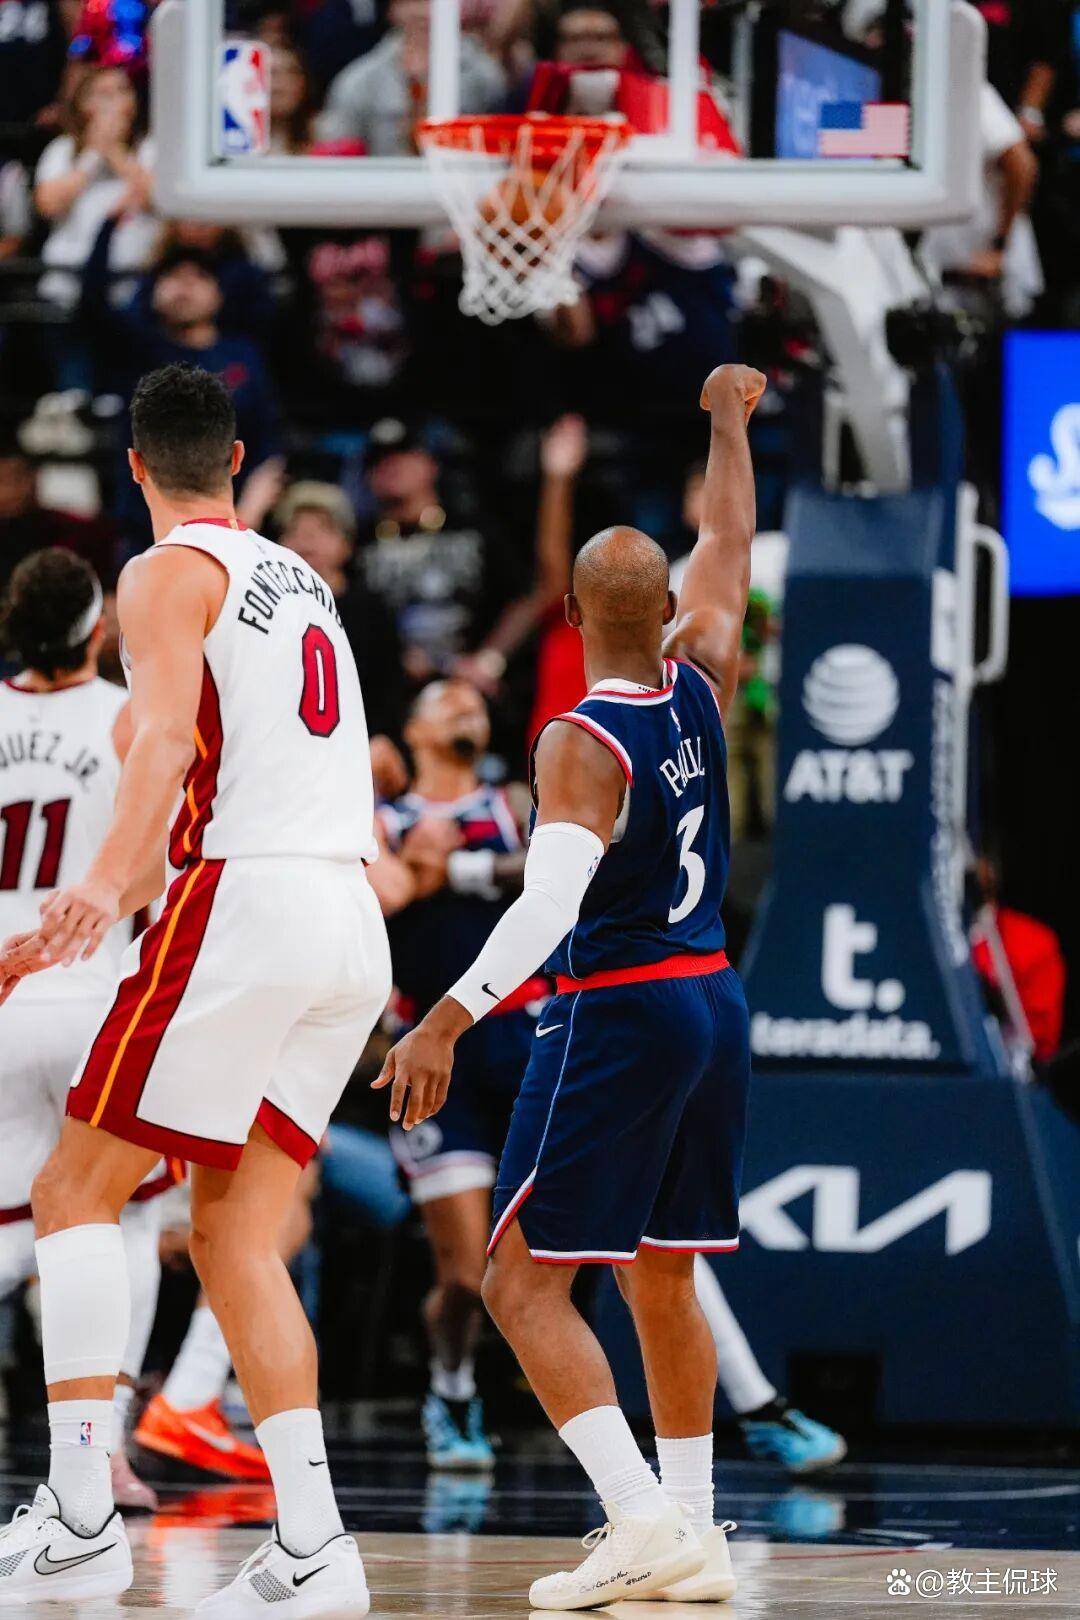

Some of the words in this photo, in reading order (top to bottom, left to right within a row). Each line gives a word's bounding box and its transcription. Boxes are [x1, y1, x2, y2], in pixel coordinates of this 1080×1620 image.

[298, 622, 340, 738] 0
[659, 736, 706, 799] PAUL
[783, 749, 915, 803] AT&T
[0, 797, 72, 891] 11
[667, 804, 706, 924] 3
